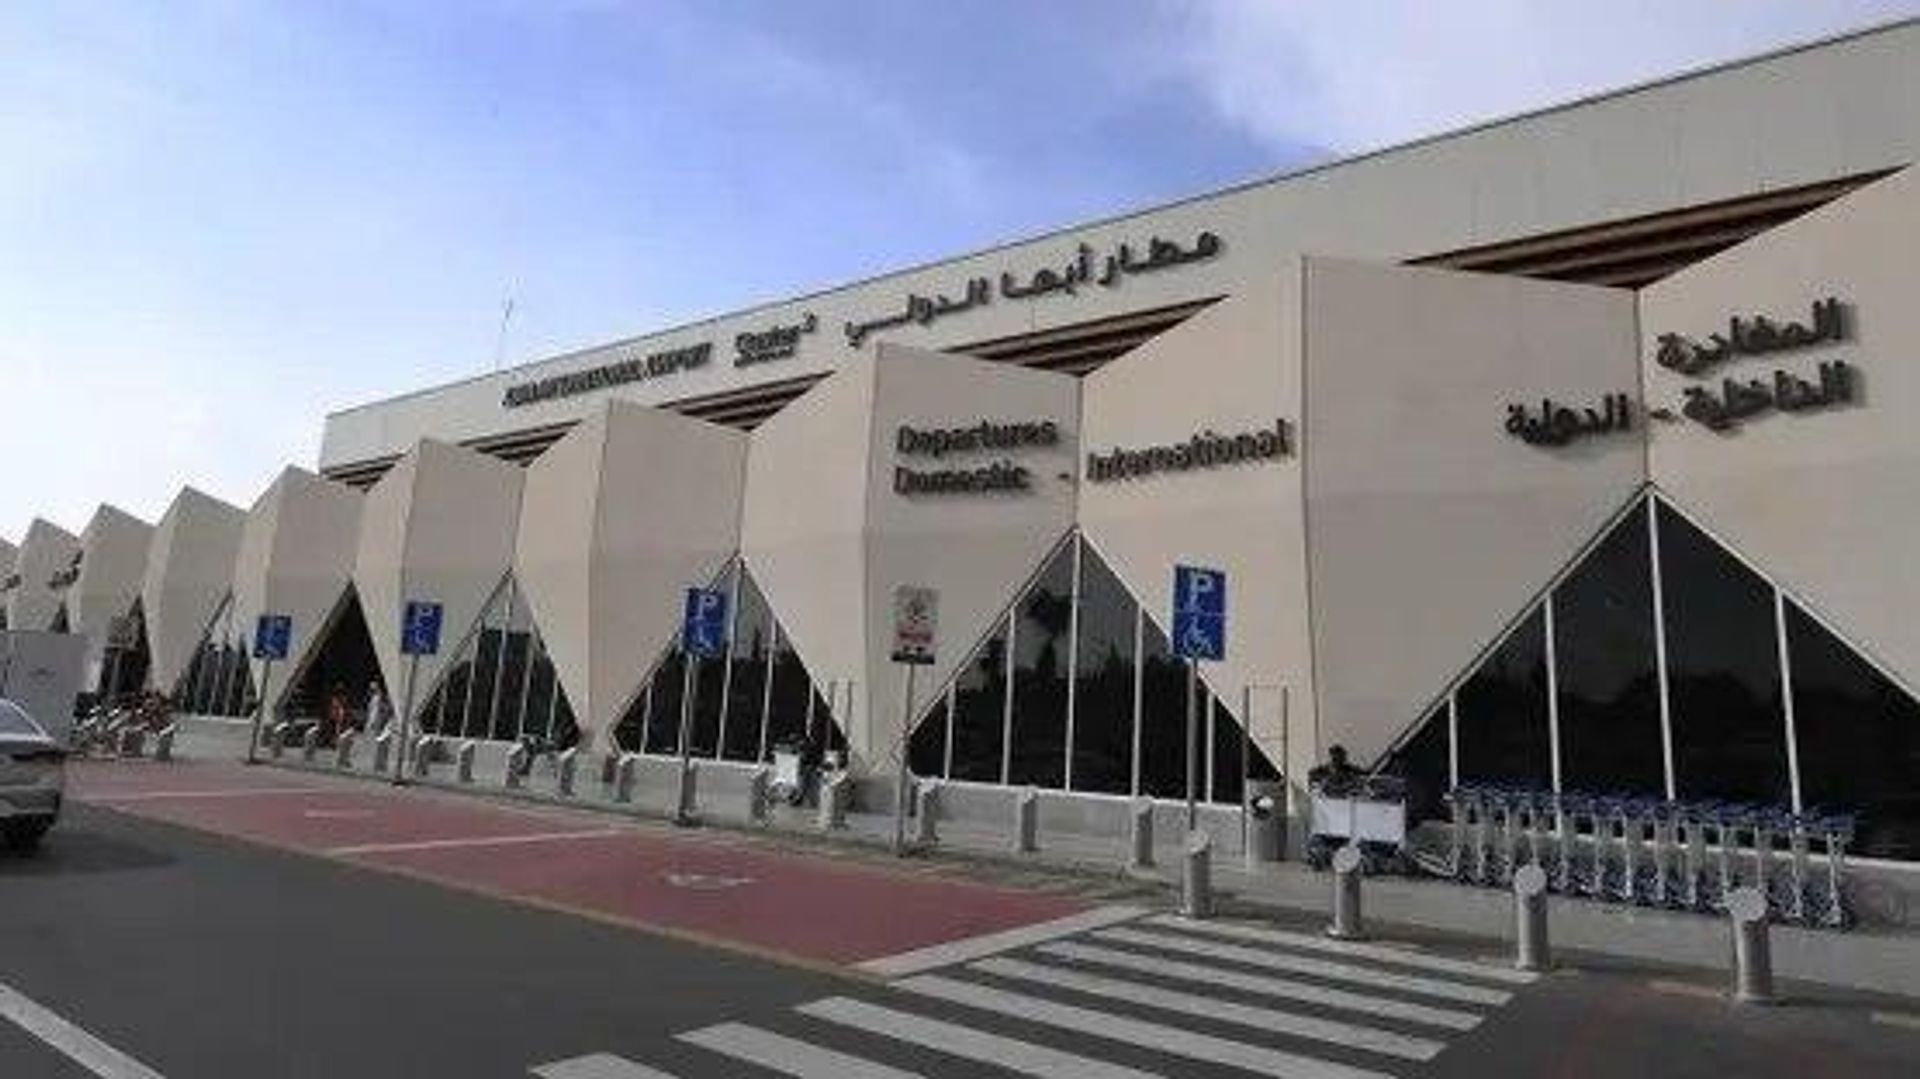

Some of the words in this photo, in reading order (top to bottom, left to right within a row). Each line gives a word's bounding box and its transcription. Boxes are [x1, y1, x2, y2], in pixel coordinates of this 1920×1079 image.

[896, 419, 1059, 456] Departures
[893, 460, 1029, 495] Domestic
[1086, 417, 1294, 482] International
[1188, 571, 1214, 604] P
[698, 594, 718, 619] P
